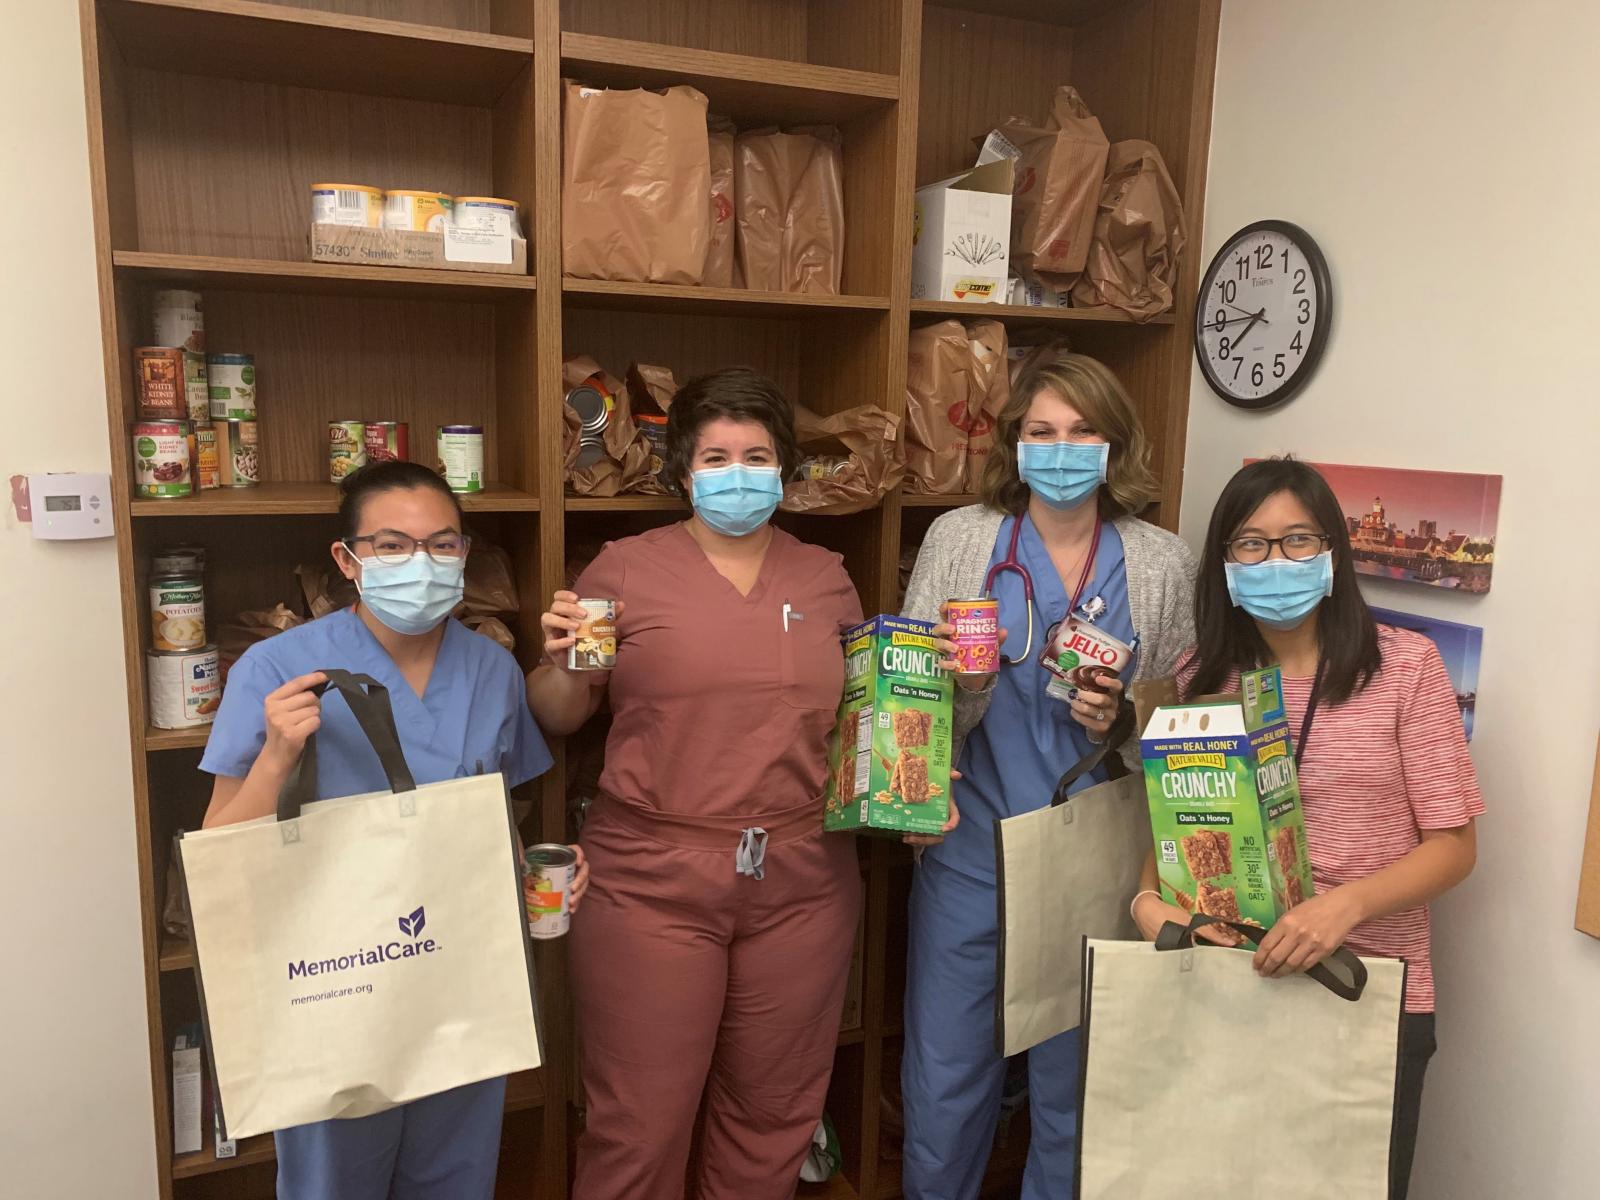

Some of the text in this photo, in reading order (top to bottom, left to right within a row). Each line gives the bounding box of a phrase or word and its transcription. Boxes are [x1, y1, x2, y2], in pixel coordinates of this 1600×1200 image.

[1235, 254, 1250, 281] 11
[1253, 243, 1274, 270] 12
[1280, 248, 1289, 274] 1
[1218, 279, 1237, 305] 10
[1292, 268, 1307, 295] 2
[1215, 308, 1227, 333] 9
[1297, 298, 1311, 325] 3
[1218, 336, 1230, 361] 8
[1289, 329, 1303, 356] 4
[1232, 356, 1244, 380] 7
[1251, 362, 1264, 387] 6
[1272, 353, 1286, 379] 5
[148, 390, 175, 398] KIDNEY
[894, 632, 920, 644] NATURE
[920, 635, 935, 647] VALL
[908, 623, 927, 634] REAL
[956, 624, 996, 634] RINGS
[1063, 633, 1118, 666] JELL-O
[893, 685, 909, 695] Oats
[918, 690, 939, 700] Honey
[1183, 742, 1206, 752] REAL
[1207, 741, 1238, 751] HONEY
[1169, 755, 1225, 767] NATURE VALLEY
[1161, 771, 1237, 799] CRUNCHY
[1256, 756, 1294, 795] CRUNCHY
[1179, 814, 1197, 822] Oats
[1207, 814, 1231, 823] Honey
[1163, 843, 1174, 853] 49
[1243, 836, 1255, 846] NO
[1248, 892, 1265, 901] OATS
[291, 983, 373, 1006] memorialcare.org
